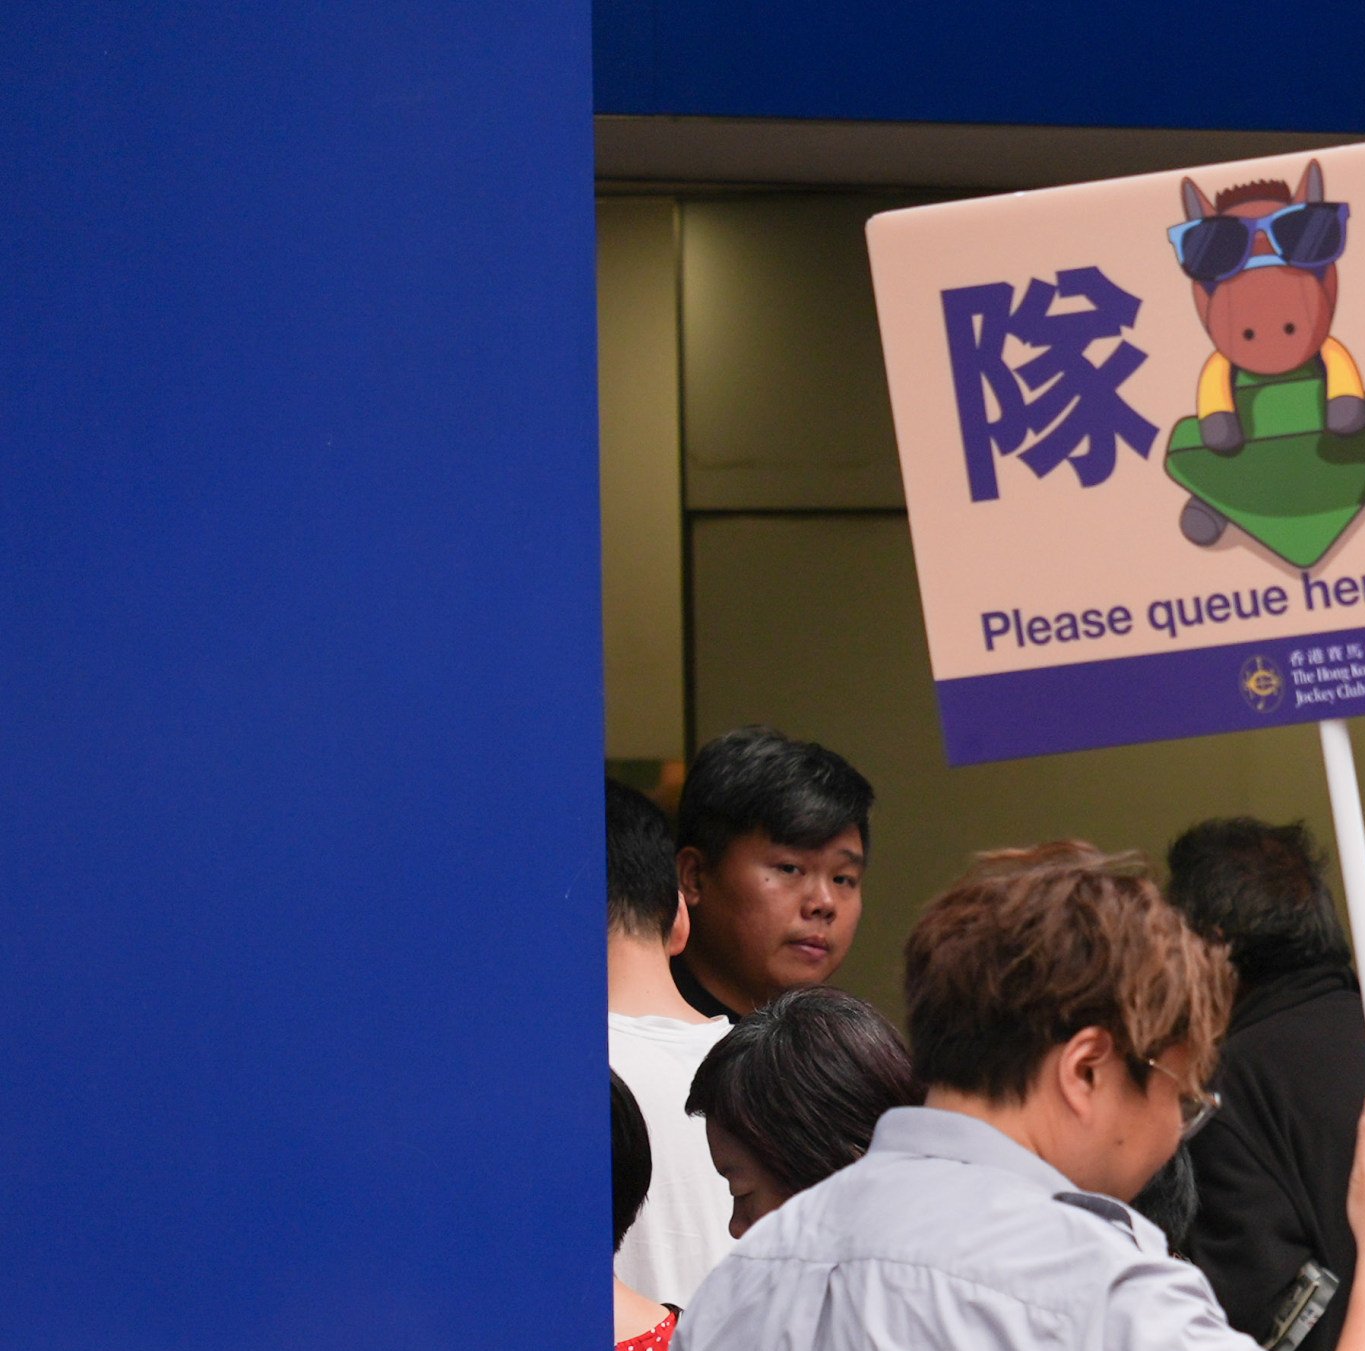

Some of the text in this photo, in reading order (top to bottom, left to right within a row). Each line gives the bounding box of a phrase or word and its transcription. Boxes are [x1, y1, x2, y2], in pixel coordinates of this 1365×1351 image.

[940, 266, 1160, 502] 隊
[980, 604, 1132, 650] Please
[1147, 584, 1288, 638] queue
[1292, 670, 1315, 685] The
[1316, 666, 1350, 683] Hong
[1295, 687, 1335, 708] Jockey
